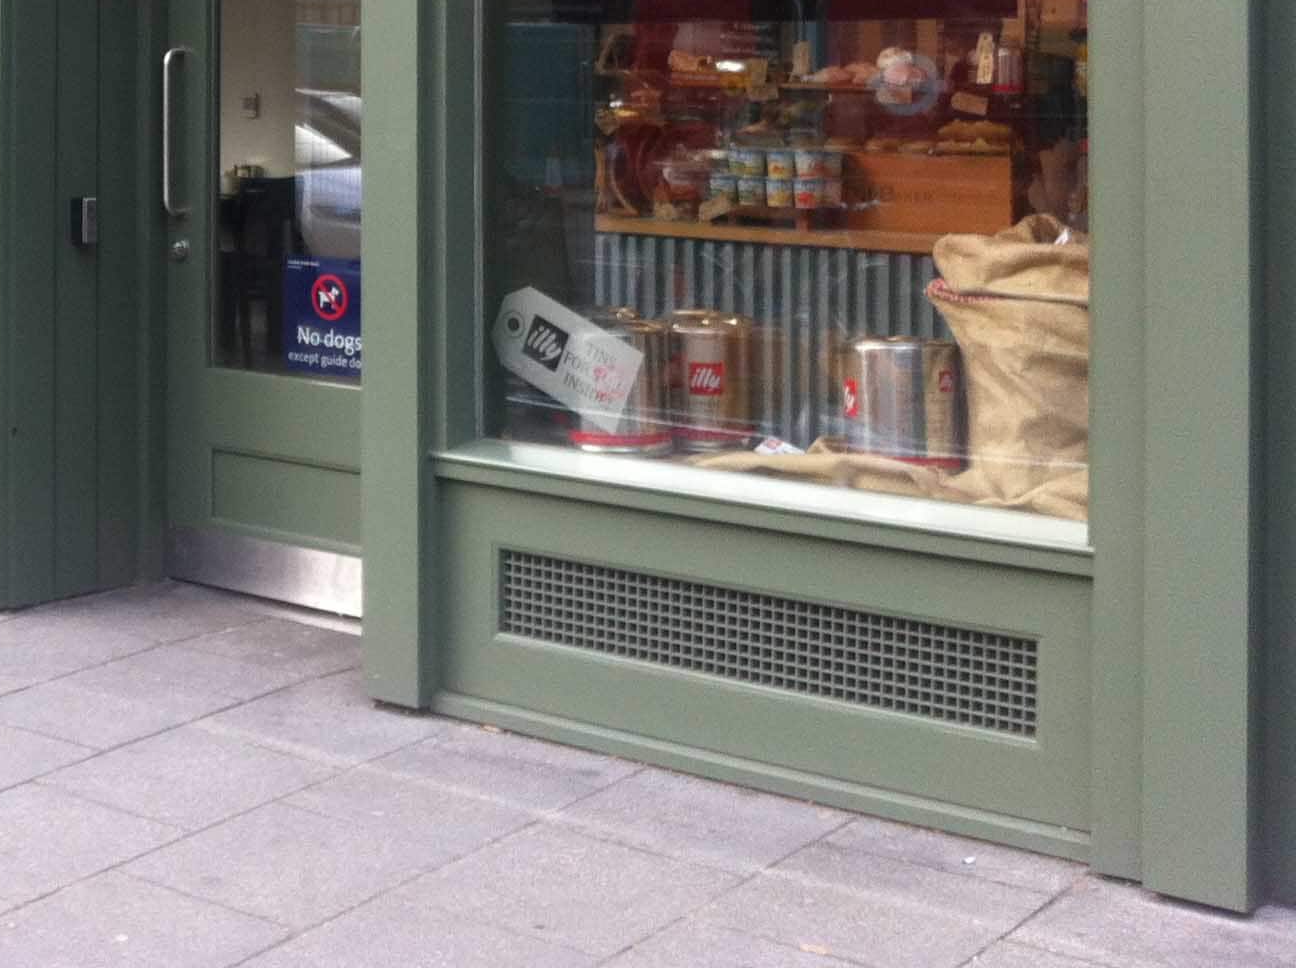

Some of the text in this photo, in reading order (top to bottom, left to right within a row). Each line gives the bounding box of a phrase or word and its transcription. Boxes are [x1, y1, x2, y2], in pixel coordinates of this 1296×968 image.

[297, 325, 362, 356] No dogs
[527, 325, 562, 362] illy
[288, 351, 362, 369] except guide do
[691, 367, 721, 395] illy
